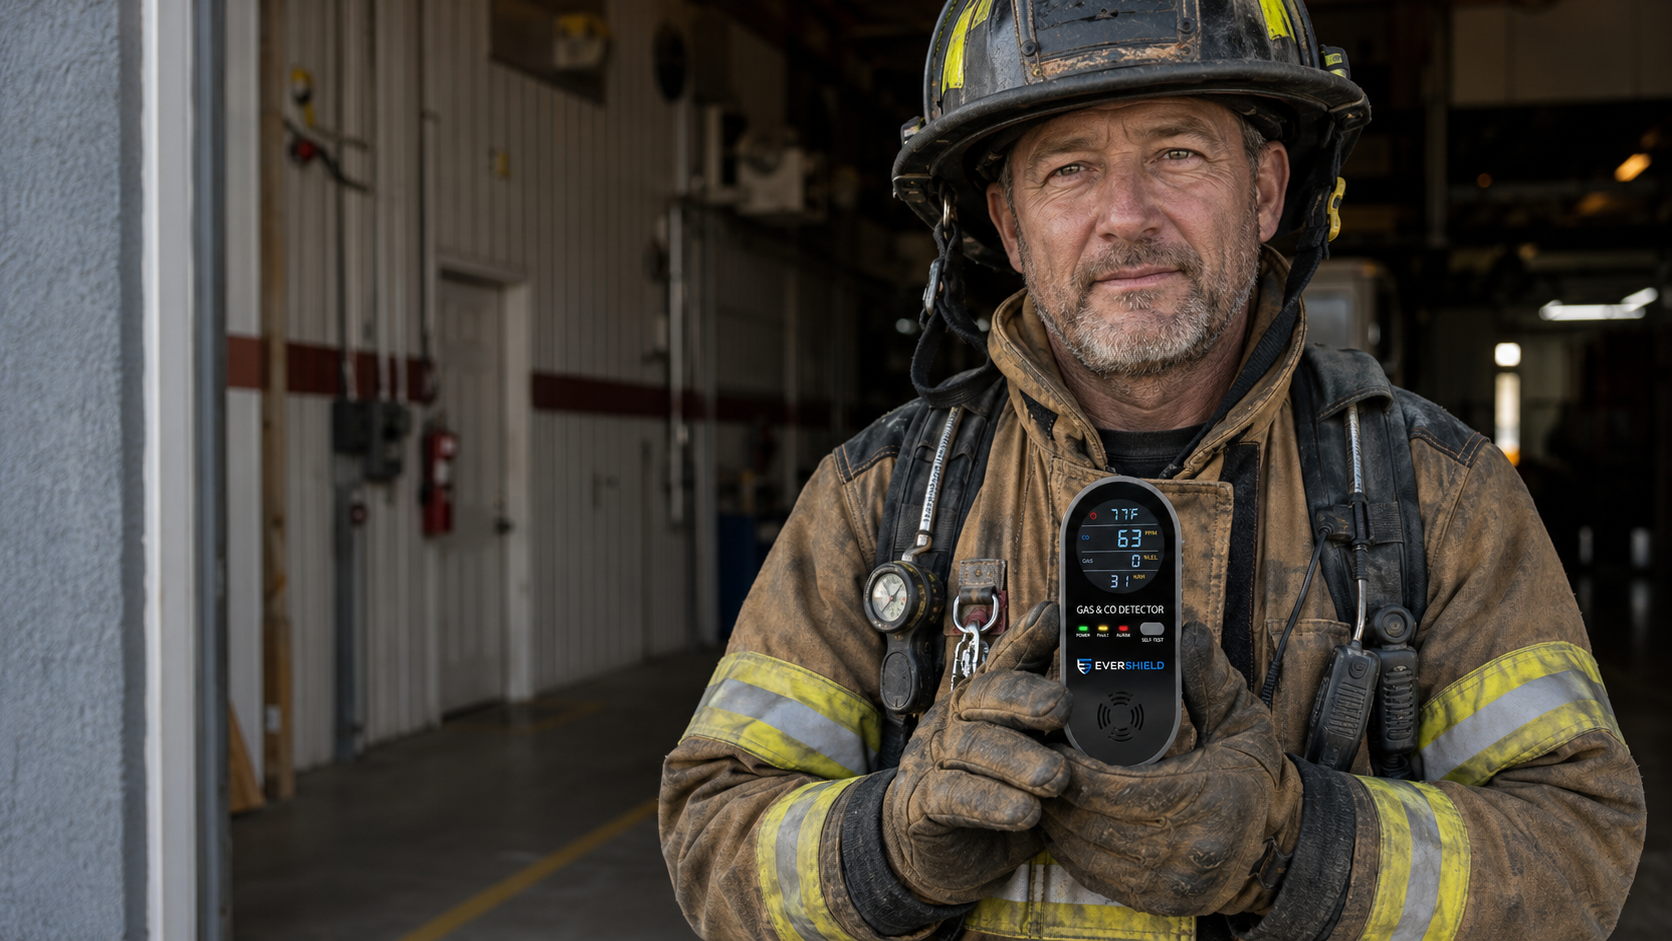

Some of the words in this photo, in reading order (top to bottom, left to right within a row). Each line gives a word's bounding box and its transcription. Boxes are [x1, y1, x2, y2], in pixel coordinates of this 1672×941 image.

[1117, 529, 1142, 547] 63
[1131, 554, 1140, 567] 0
[1110, 574, 1129, 588] 31
[1076, 605, 1094, 614] GAS
[1095, 605, 1103, 614] &
[1103, 605, 1117, 614] CO
[1118, 605, 1164, 614] DETECTOR
[1095, 661, 1165, 670] EVERSHIELD
